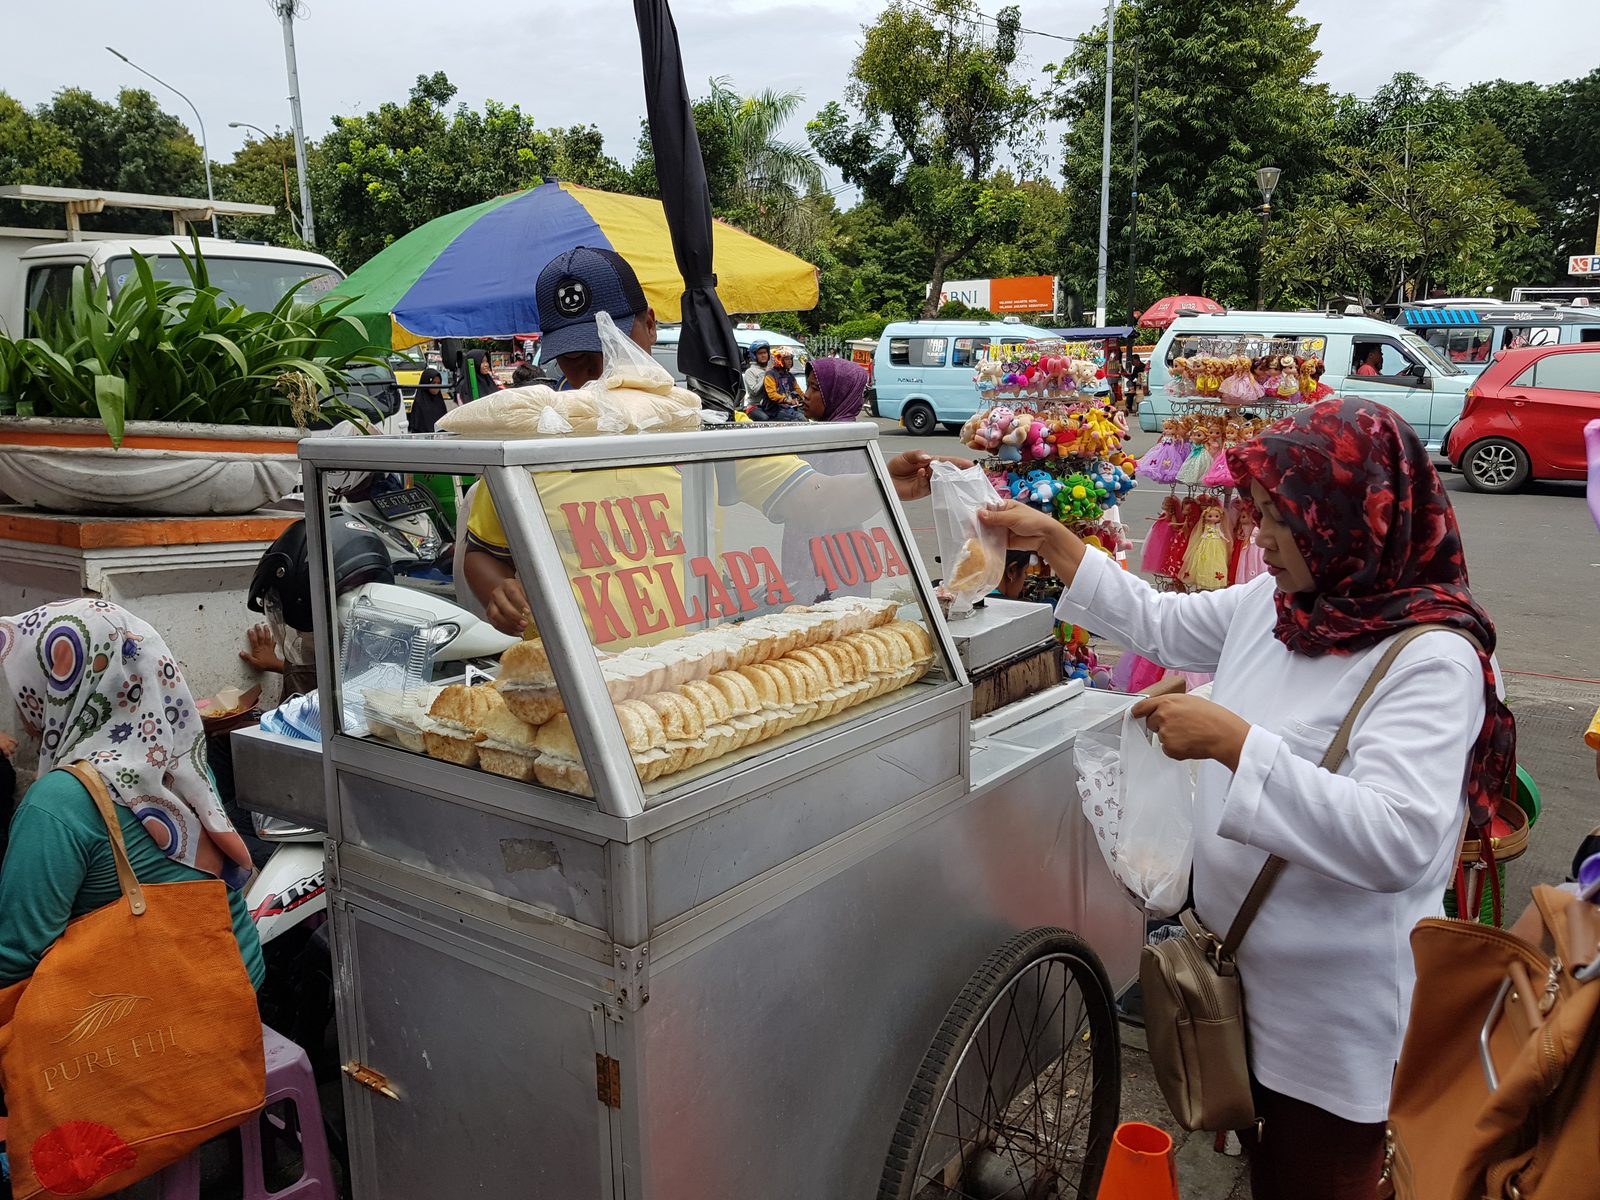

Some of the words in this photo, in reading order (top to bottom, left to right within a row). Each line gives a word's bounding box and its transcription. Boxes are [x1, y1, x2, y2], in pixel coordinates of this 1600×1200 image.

[950, 290, 977, 304] BNI
[559, 493, 686, 570] KUE
[573, 546, 795, 644] KELAPA
[41, 1046, 121, 1092] PURE
[131, 1026, 178, 1060] FIJI
